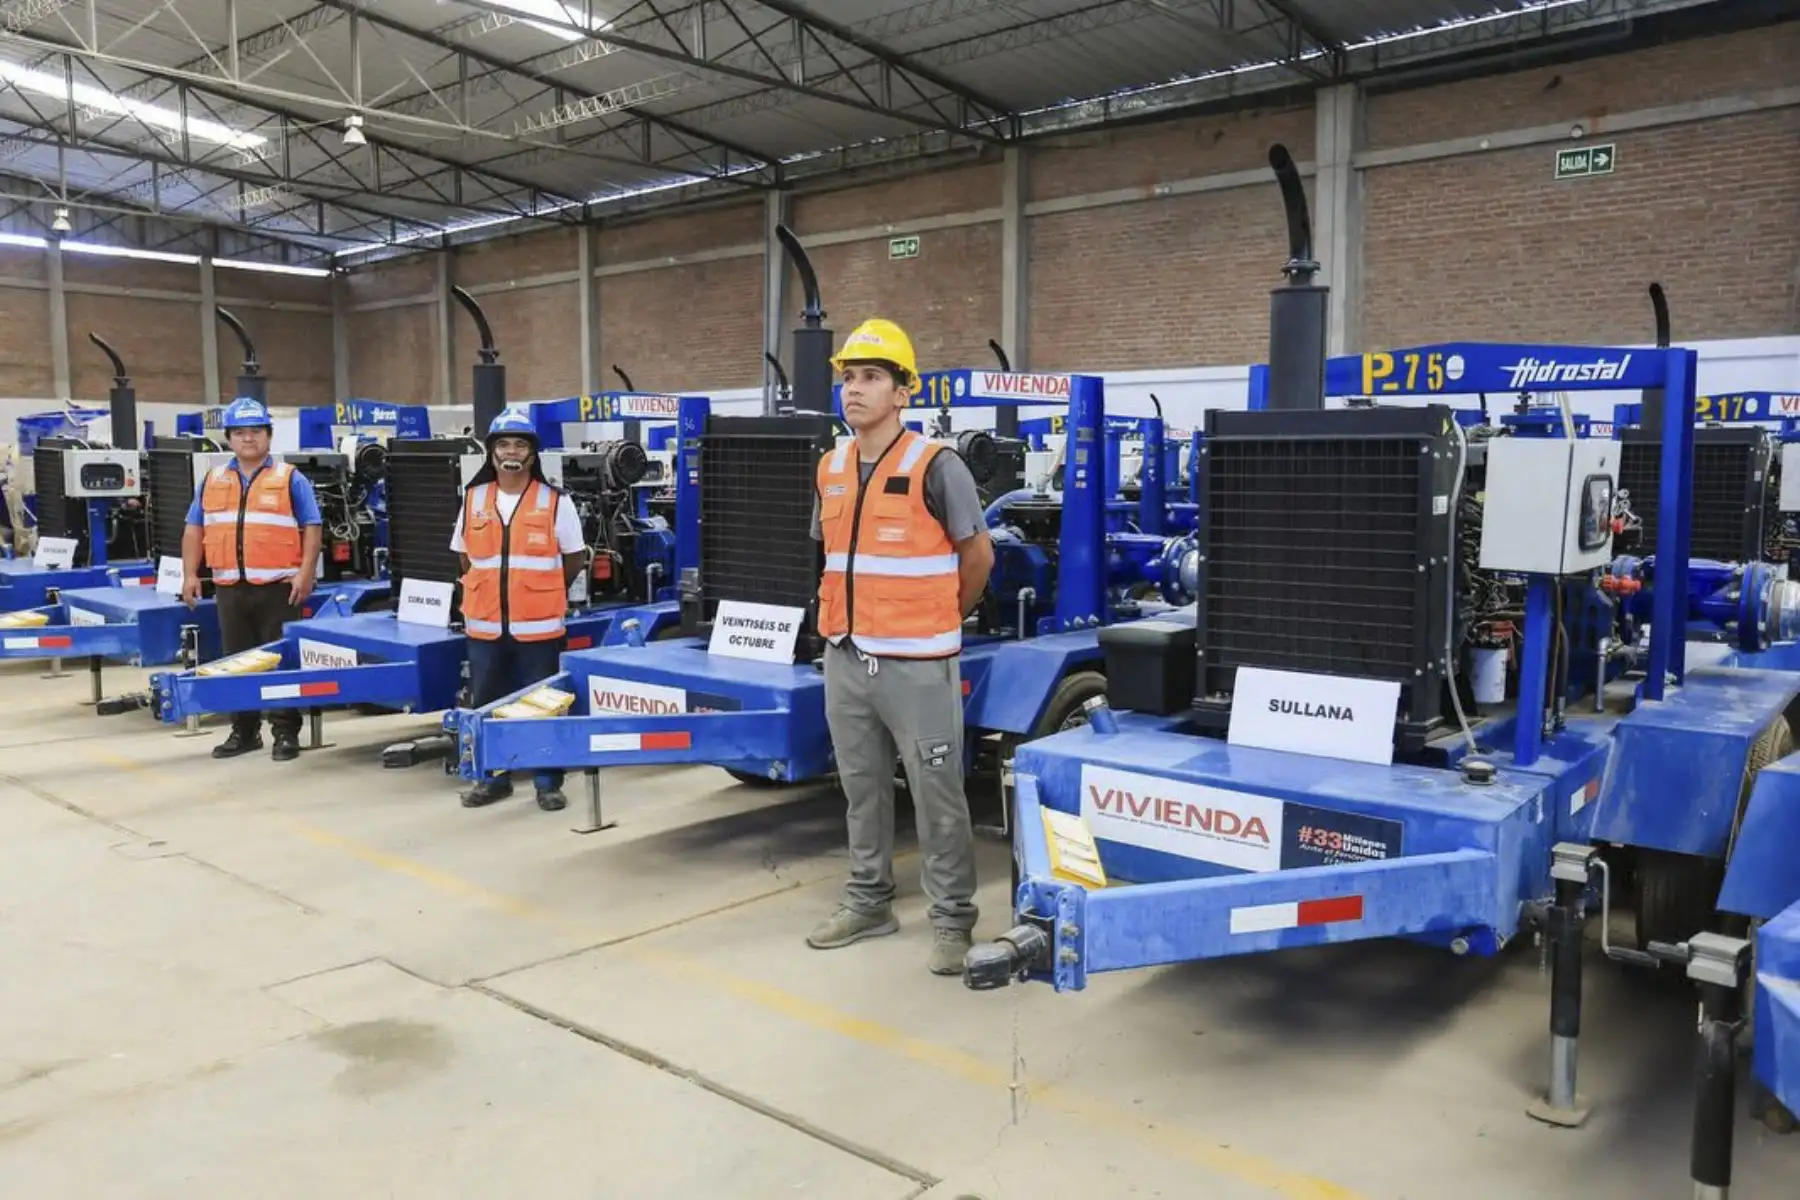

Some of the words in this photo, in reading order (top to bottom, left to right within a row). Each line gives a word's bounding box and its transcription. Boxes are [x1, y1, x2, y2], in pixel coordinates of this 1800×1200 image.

[1561, 154, 1587, 171] SALIDA
[1500, 353, 1632, 388] Hidrostal
[984, 374, 1070, 396] VIVIENDA
[722, 616, 776, 632] VEINTISÉIS
[777, 622, 792, 633] DE
[729, 634, 776, 650] OCTUBRE
[593, 689, 680, 714] VIVIENDA
[1268, 698, 1354, 722] SULLANA
[1089, 784, 1270, 844] VIVIENDA
[1343, 842, 1387, 859] Unidos
